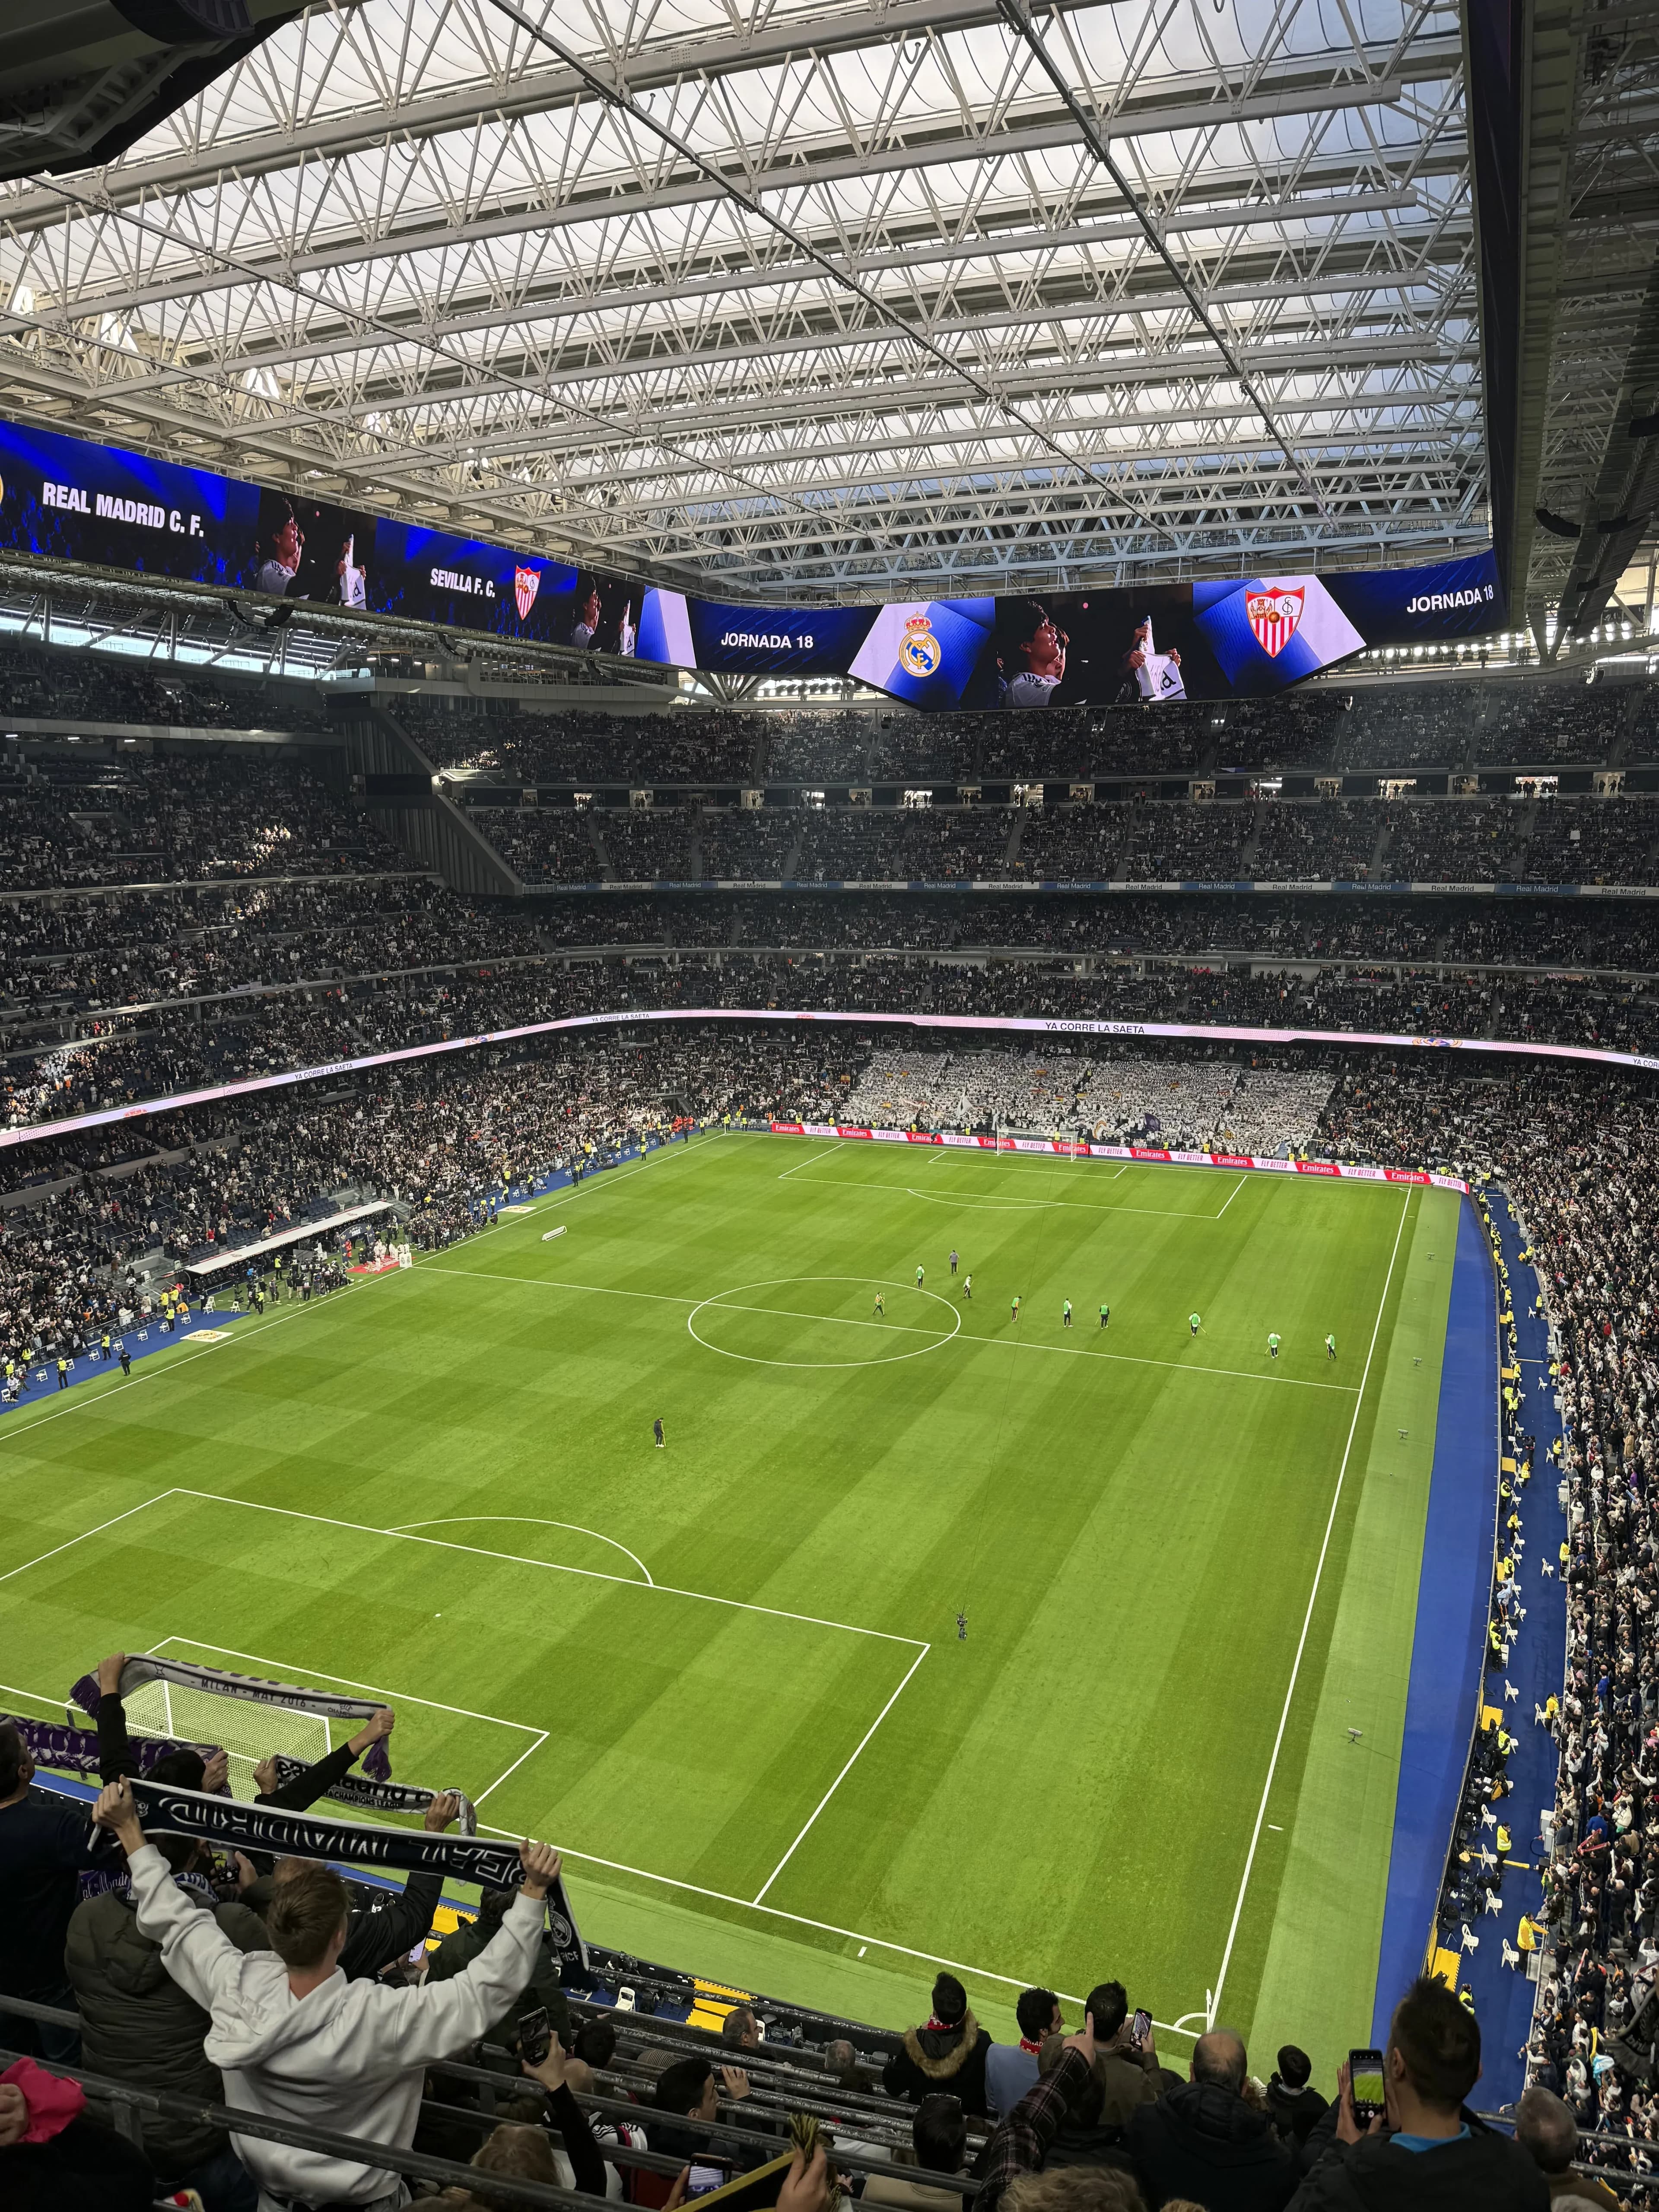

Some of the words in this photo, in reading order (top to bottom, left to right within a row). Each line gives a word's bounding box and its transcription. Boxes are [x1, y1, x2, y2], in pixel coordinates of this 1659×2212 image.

[43, 482, 91, 513] REAL
[96, 493, 165, 528] MADRID
[169, 510, 185, 533] C.
[190, 514, 204, 537] F.
[430, 568, 472, 593] SEVILLA
[474, 578, 483, 595] F.
[486, 580, 495, 598] C.
[1407, 588, 1482, 613] JORNADA
[1483, 585, 1494, 601] 18
[721, 632, 792, 648] JORNADA
[797, 635, 814, 648] 18
[1061, 1023, 1095, 1031] CORRE
[1098, 1024, 1110, 1033] LA
[1113, 1025, 1144, 1034] SAETA
[304, 1069, 324, 1078] CORRE
[334, 1063, 353, 1072] SAETA
[1643, 1060, 1659, 1068] COR
[1217, 1157, 1248, 1165] Emirates
[1302, 1164, 1334, 1173] Emirates
[1391, 1173, 1424, 1182] Emirates
[201, 1679, 237, 1694] MILAN
[280, 1697, 306, 1707] 2016
[334, 1792, 375, 1805] CHAMPIONS
